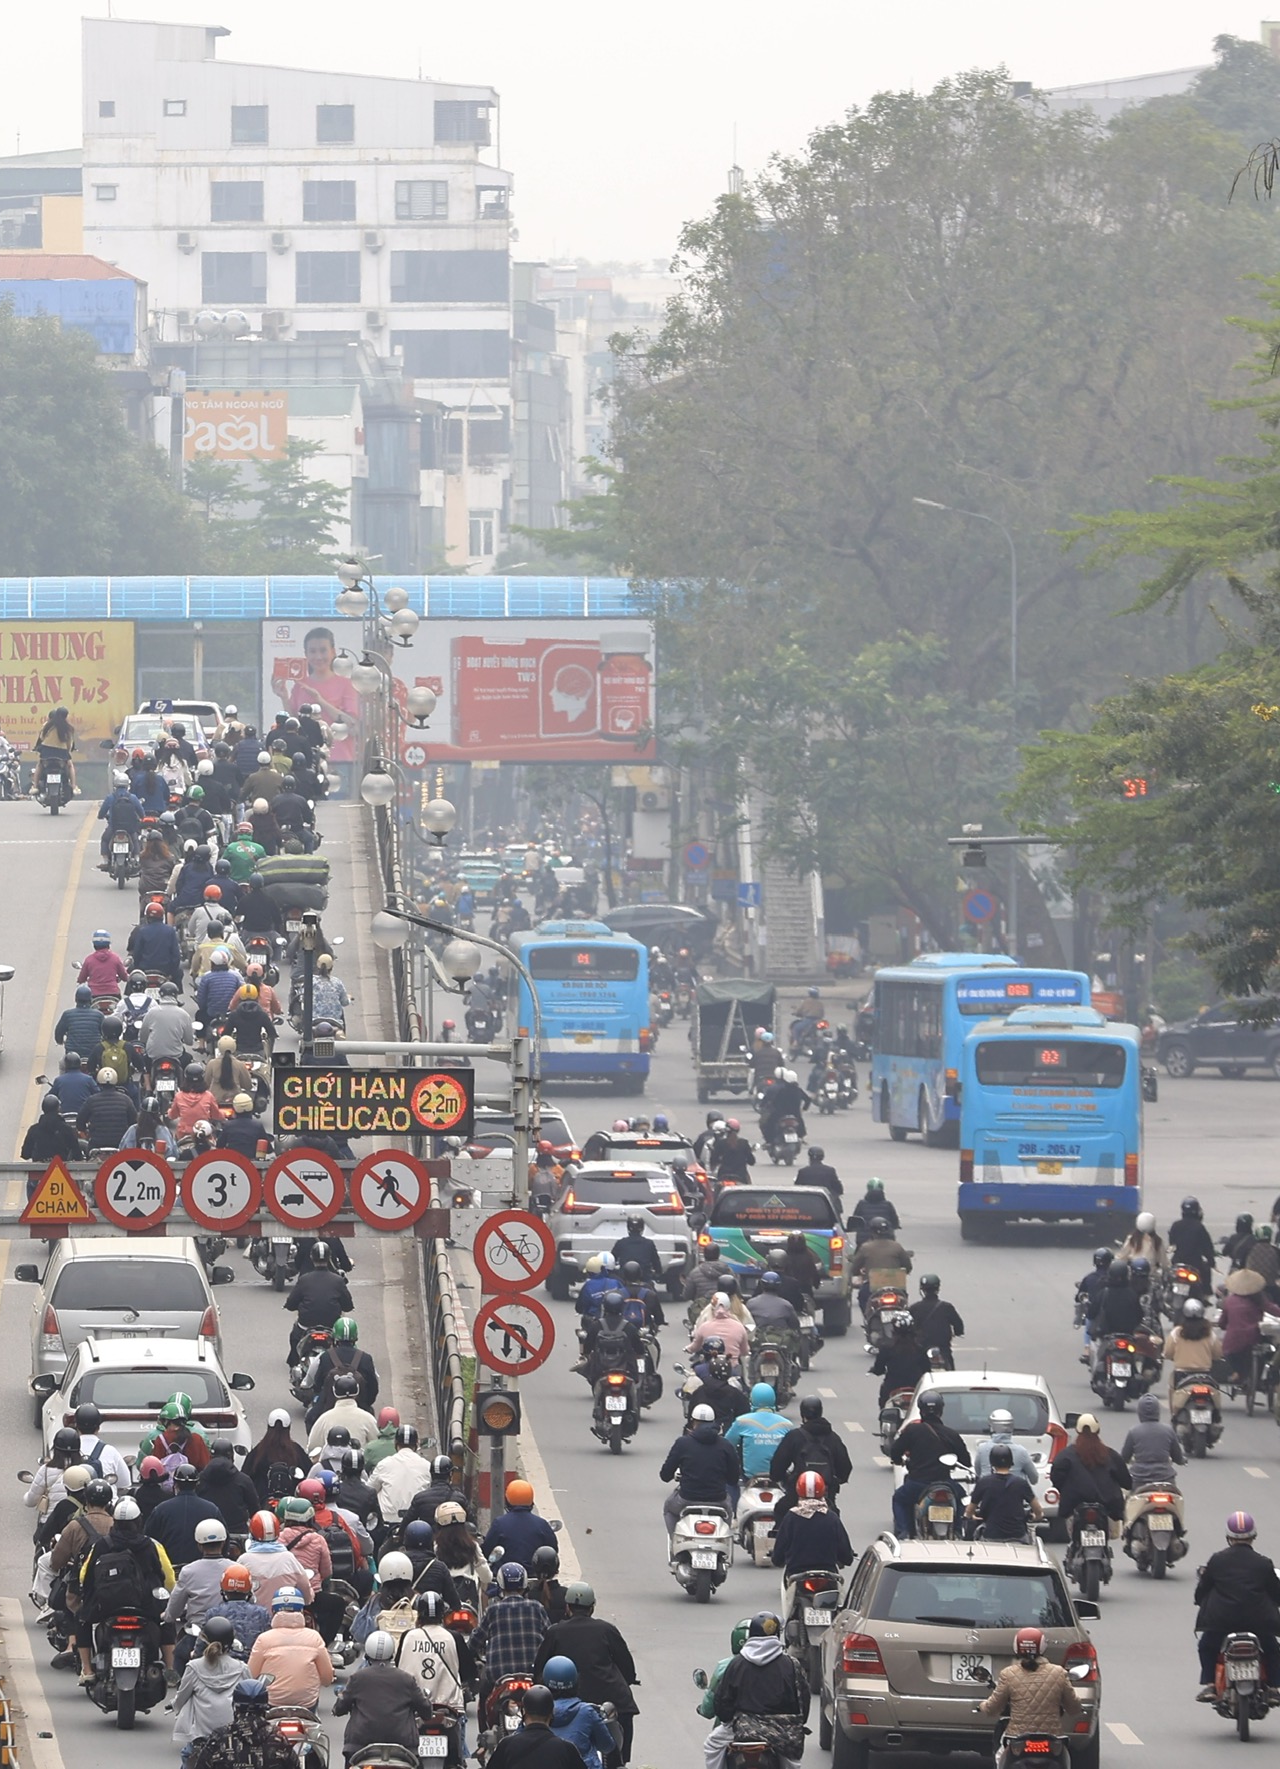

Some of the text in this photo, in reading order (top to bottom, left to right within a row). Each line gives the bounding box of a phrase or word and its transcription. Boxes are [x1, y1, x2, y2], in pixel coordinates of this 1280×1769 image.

[10, 630, 107, 661] NHUNG
[283, 1072, 406, 1100] GIỚI HẠN
[49, 1183, 64, 1196] ĐI
[35, 1198, 79, 1216] CHẬM
[421, 1658, 436, 1680] 8
[419, 1746, 446, 1756] 810.61
